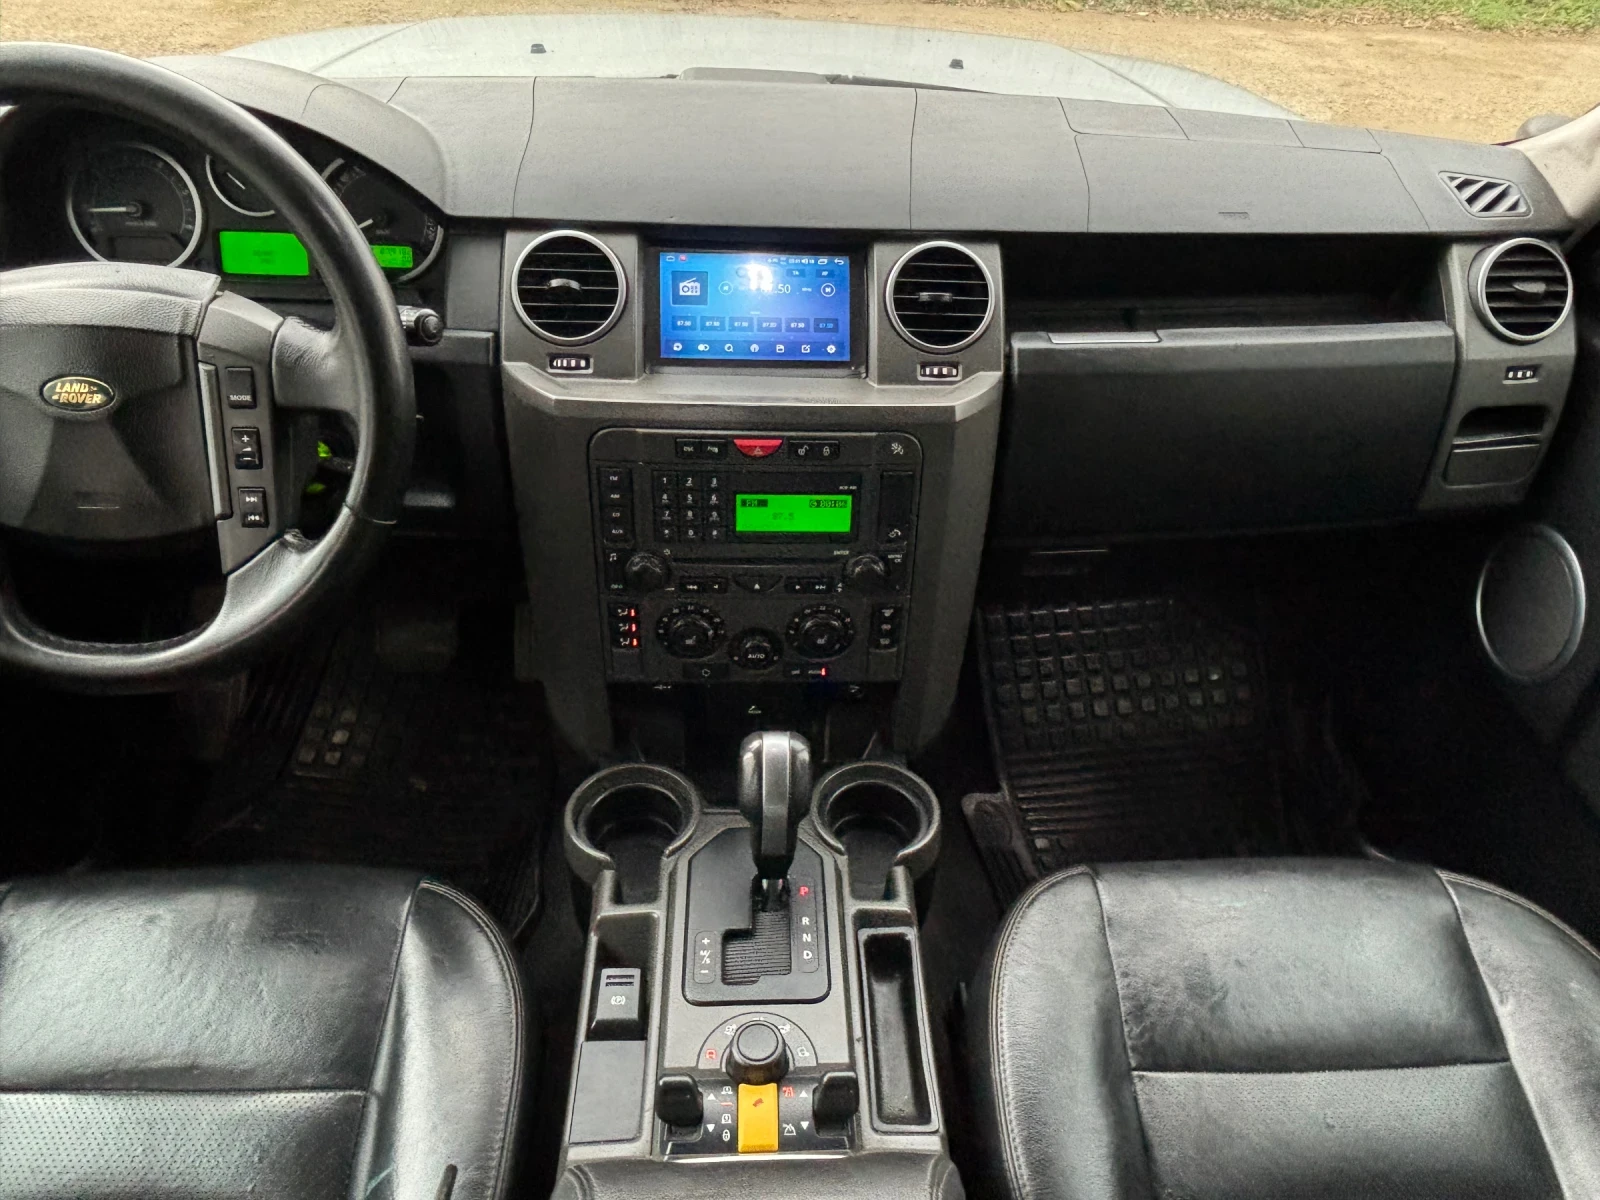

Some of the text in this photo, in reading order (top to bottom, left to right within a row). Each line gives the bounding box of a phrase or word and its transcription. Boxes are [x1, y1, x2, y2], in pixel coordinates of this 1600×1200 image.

[55, 382, 89, 393] LAND
[59, 393, 101, 404] ROVER
[229, 394, 252, 402] MODE
[799, 886, 809, 897] P
[802, 917, 810, 926] R
[803, 933, 811, 943] N
[803, 950, 812, 960] D
